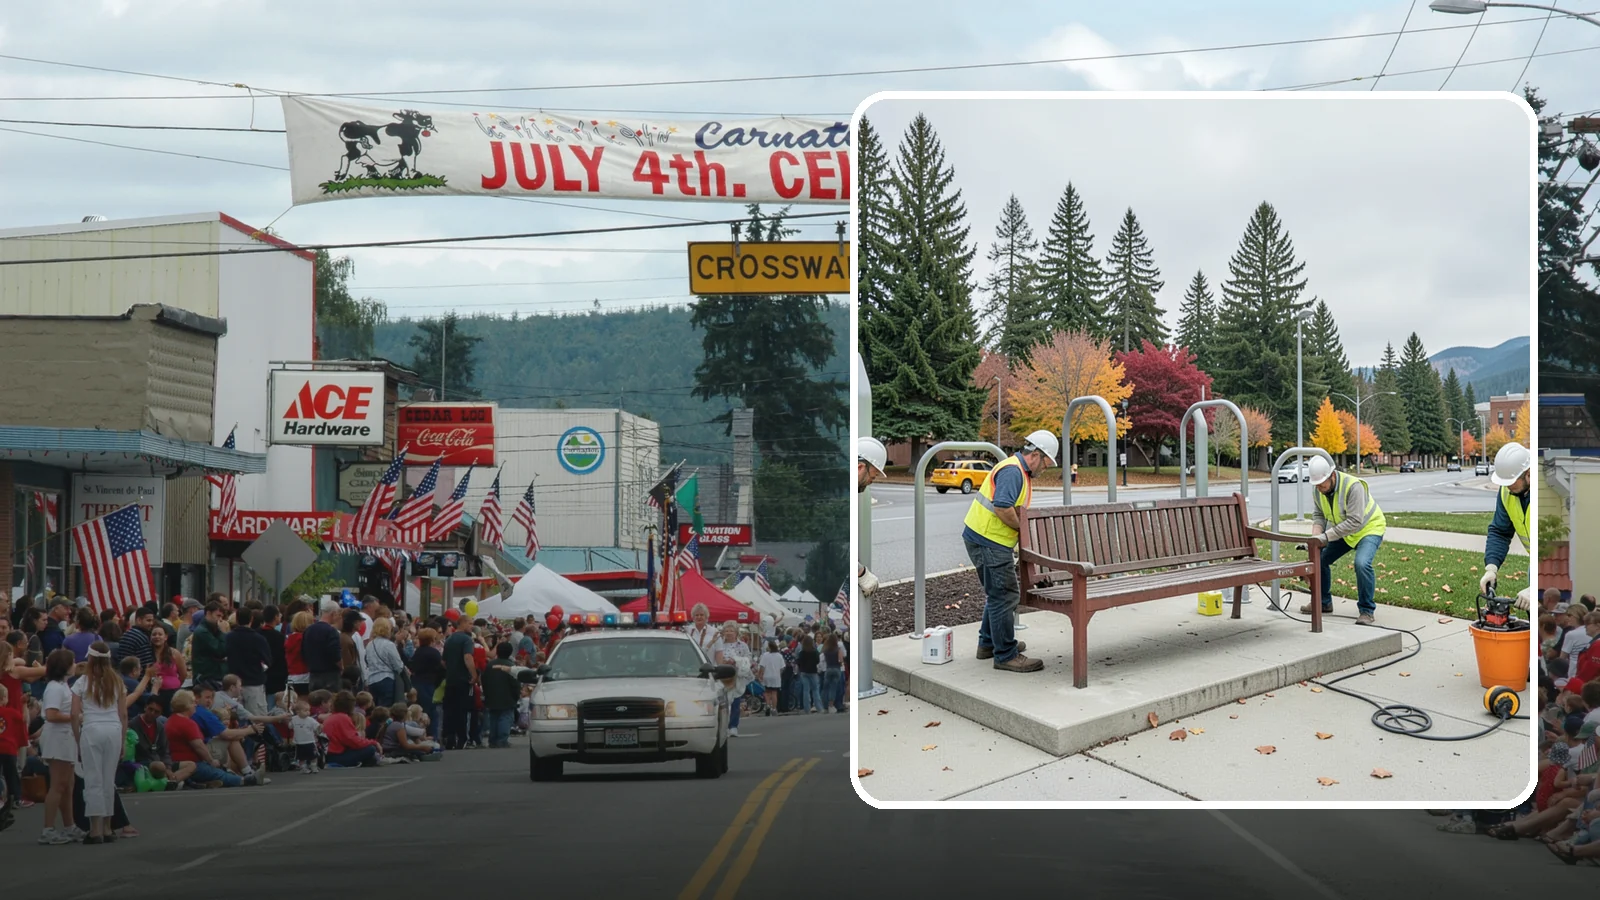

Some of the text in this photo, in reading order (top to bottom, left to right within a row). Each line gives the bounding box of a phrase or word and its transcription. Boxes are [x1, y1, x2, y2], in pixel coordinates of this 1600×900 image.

[481, 141, 605, 192] JULY
[632, 150, 747, 198] 4th.
[697, 254, 850, 280] CROSSWA
[282, 380, 373, 420] ACE
[405, 409, 486, 422] CEDAR LOG
[283, 421, 371, 436] Hardware
[83, 484, 155, 495] St. Vincent de Paul
[688, 526, 741, 535] CRNATION
[699, 535, 730, 543] GLASS
